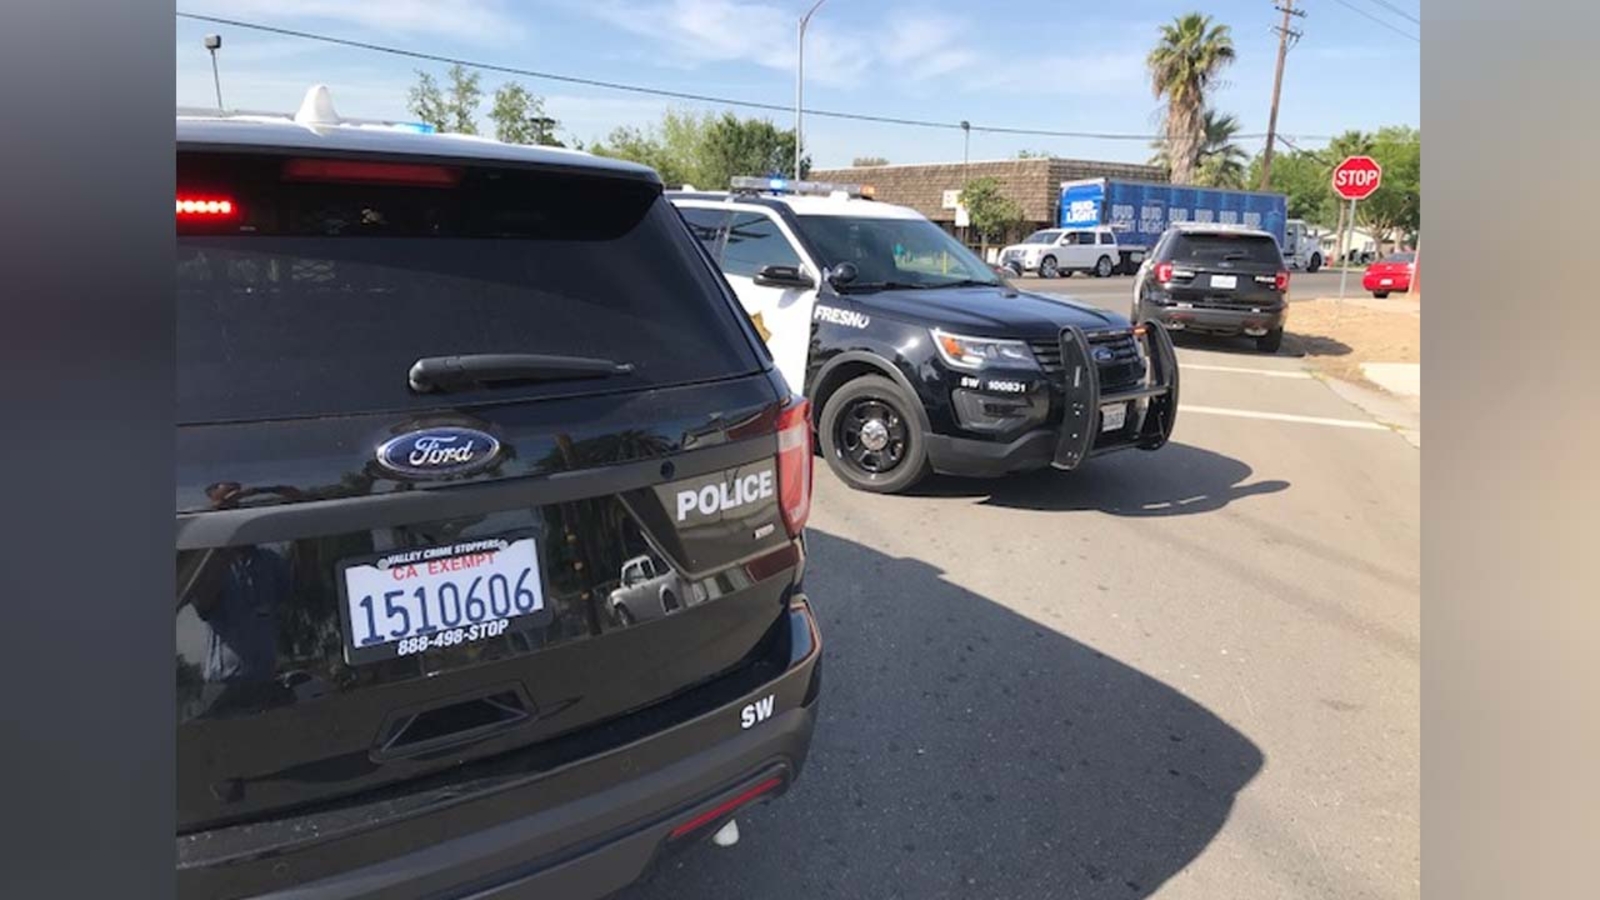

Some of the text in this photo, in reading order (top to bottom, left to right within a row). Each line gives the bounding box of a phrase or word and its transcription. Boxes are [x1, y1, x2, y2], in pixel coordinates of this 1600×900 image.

[1336, 169, 1378, 186] STOP
[814, 304, 870, 329] FRESNO
[961, 376, 979, 388] SW
[409, 435, 474, 465] Ford
[677, 470, 773, 521] POLICE
[387, 539, 500, 565] VALLEY CRIME STOPPERS
[392, 551, 497, 581] CA EXEMPT
[360, 567, 535, 645] 1510606
[397, 618, 509, 656] 888-498-STOP
[741, 694, 775, 728] SW
